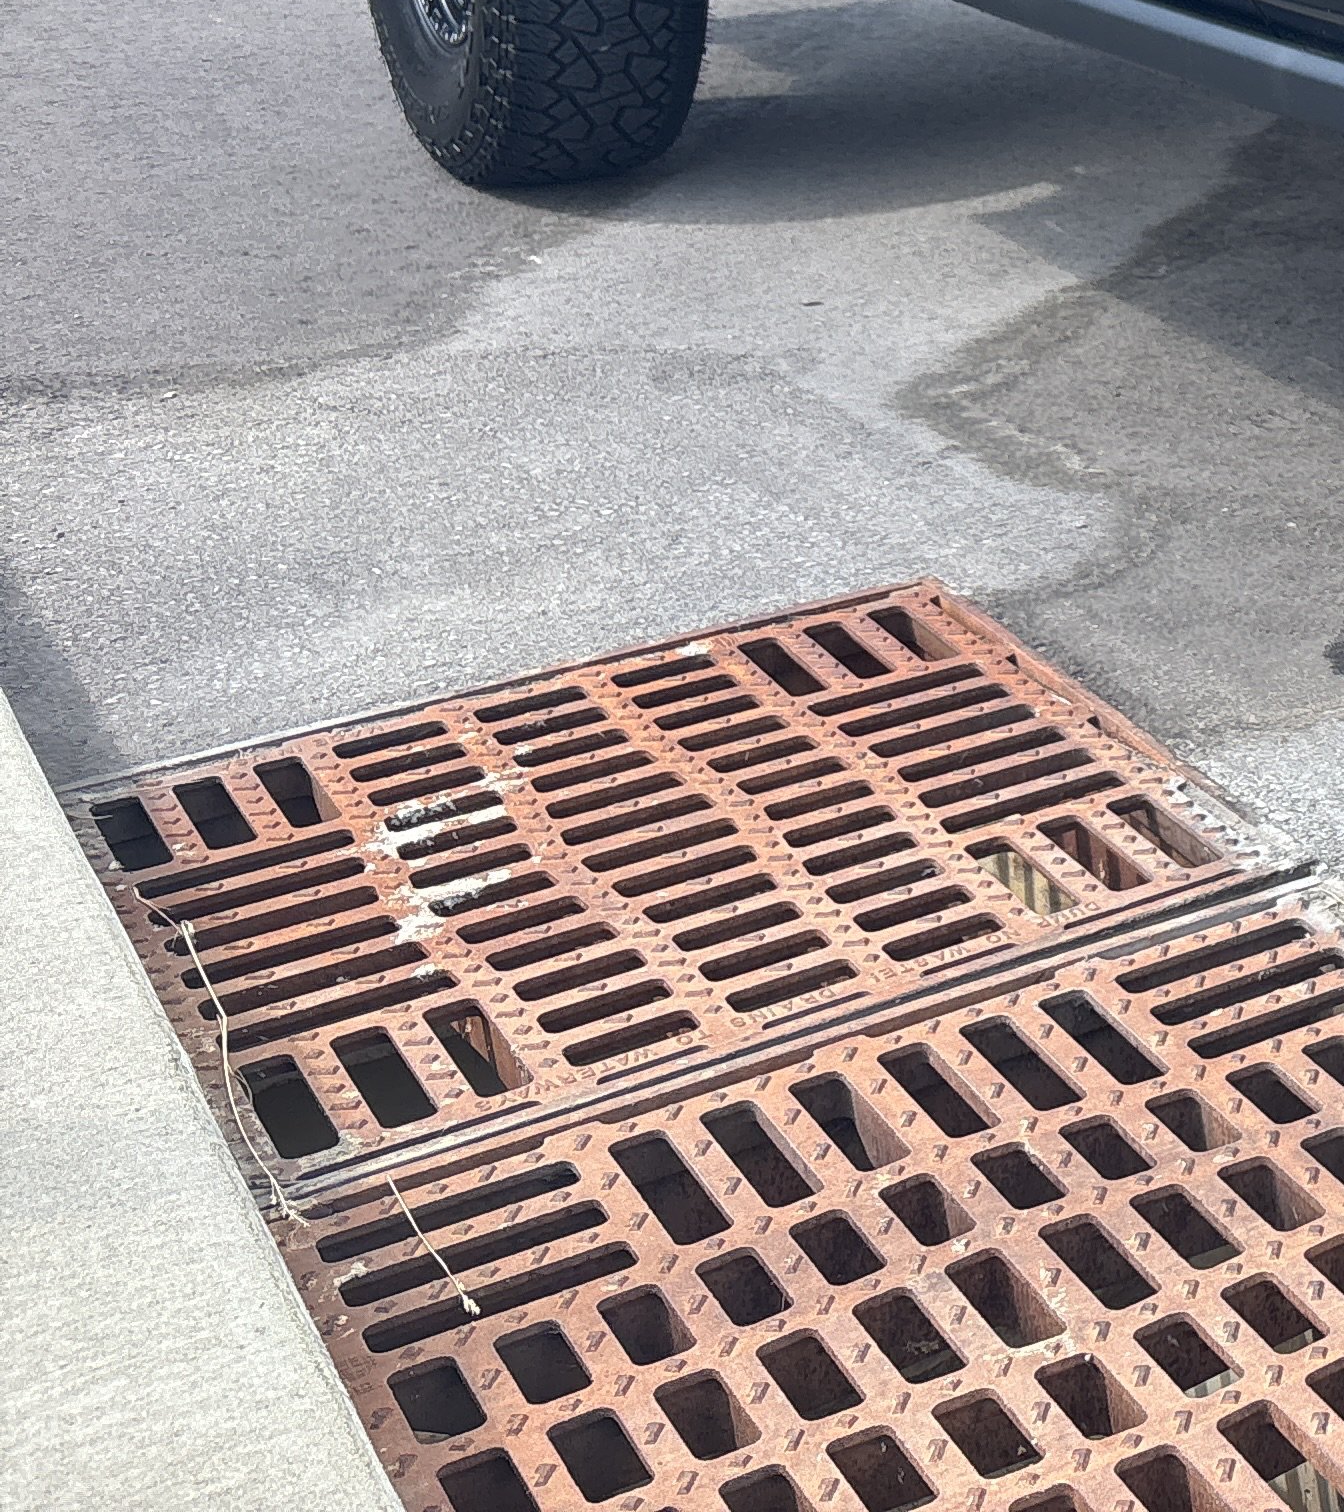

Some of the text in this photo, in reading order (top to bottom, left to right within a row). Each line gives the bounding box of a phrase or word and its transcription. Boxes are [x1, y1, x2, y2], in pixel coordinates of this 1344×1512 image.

[729, 988, 838, 1029] DRAINS
[676, 1031, 713, 1046] TO
[474, 1047, 658, 1112] WATERWAYS
